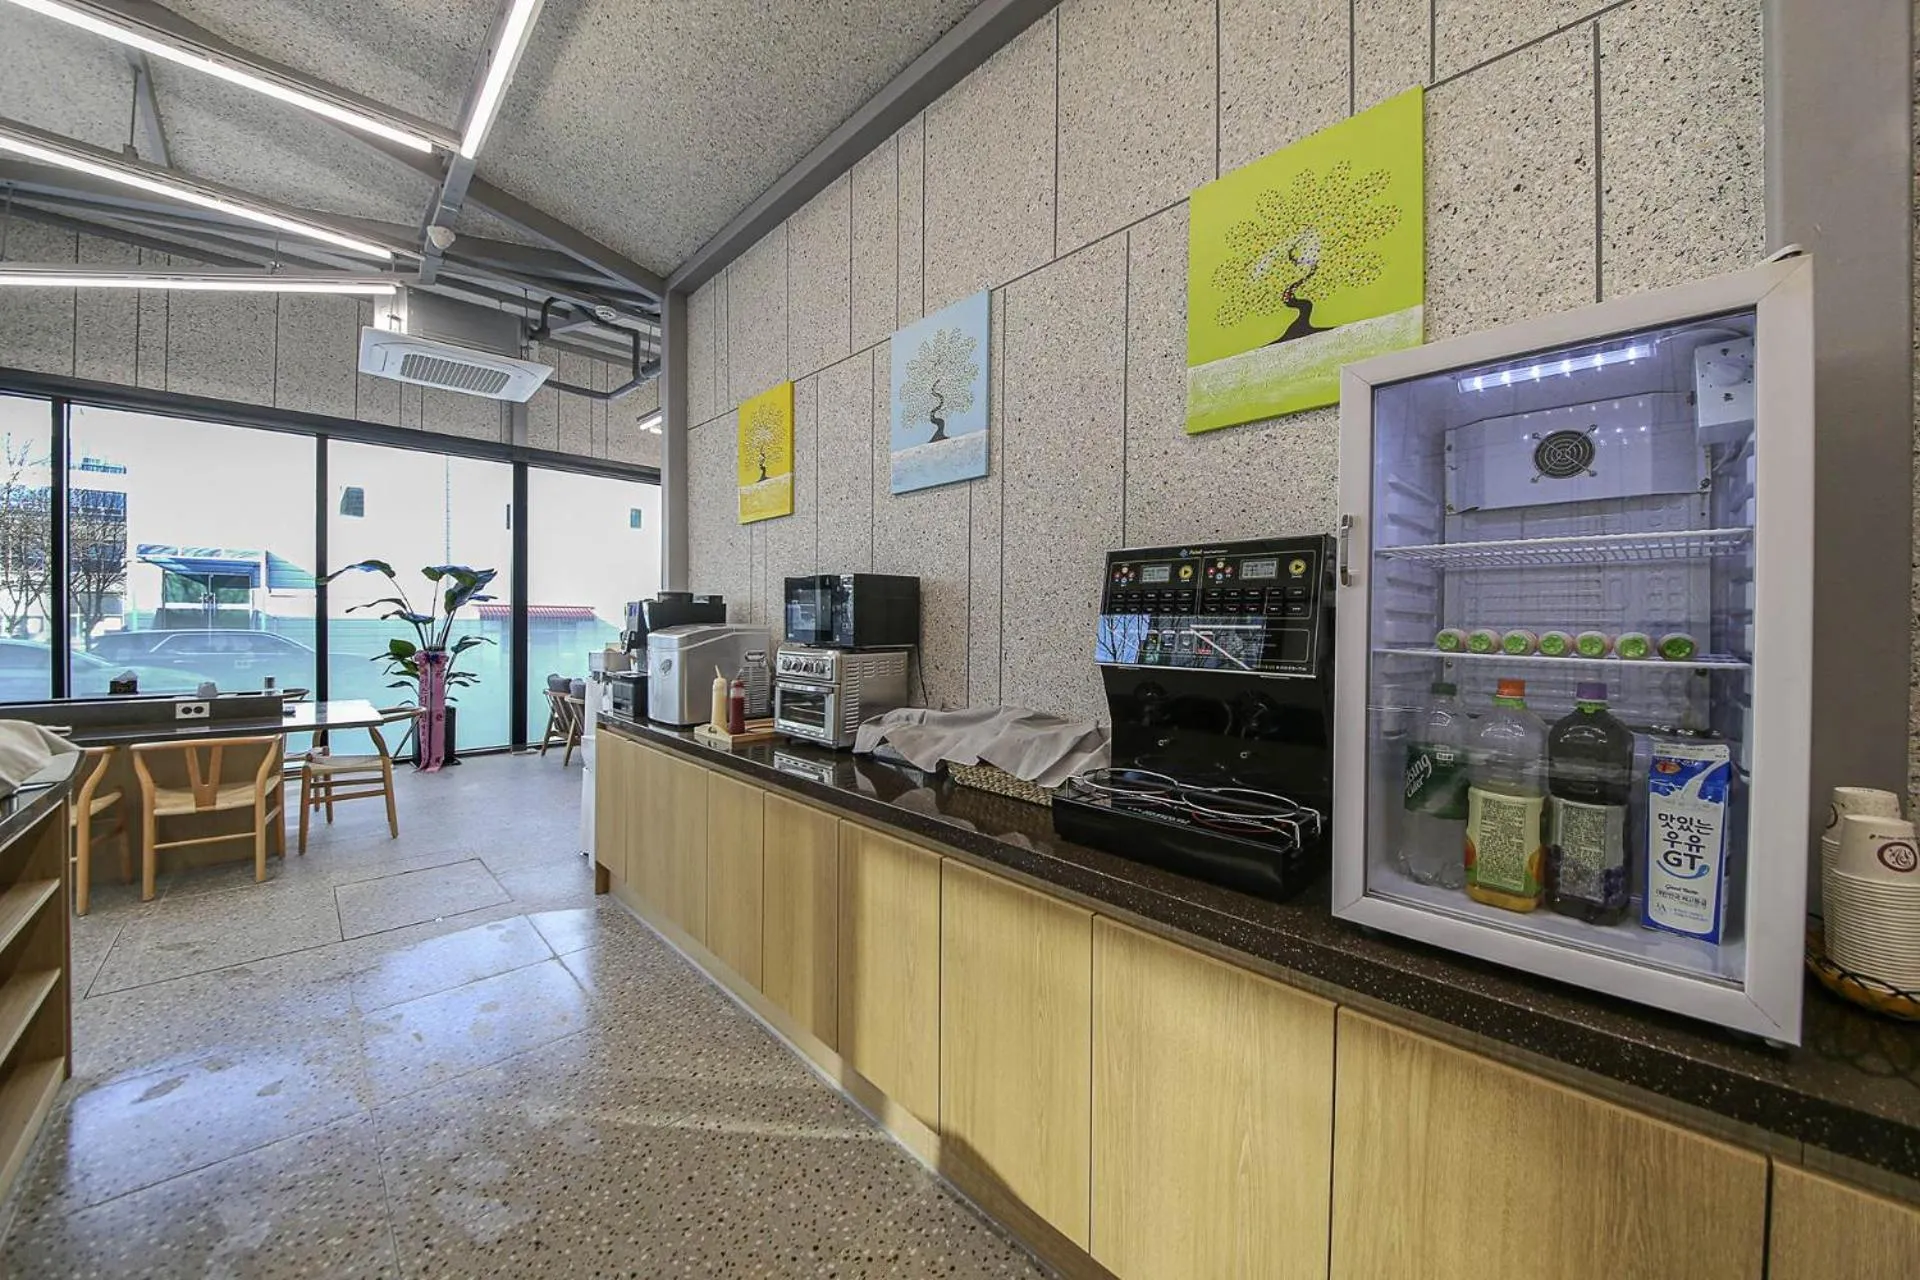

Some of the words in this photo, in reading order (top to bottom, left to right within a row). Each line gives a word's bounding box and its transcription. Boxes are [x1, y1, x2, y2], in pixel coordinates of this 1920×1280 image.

[1658, 813, 1714, 836] 맛있는
[1663, 831, 1706, 853] 우유
[1663, 850, 1704, 871] GT
